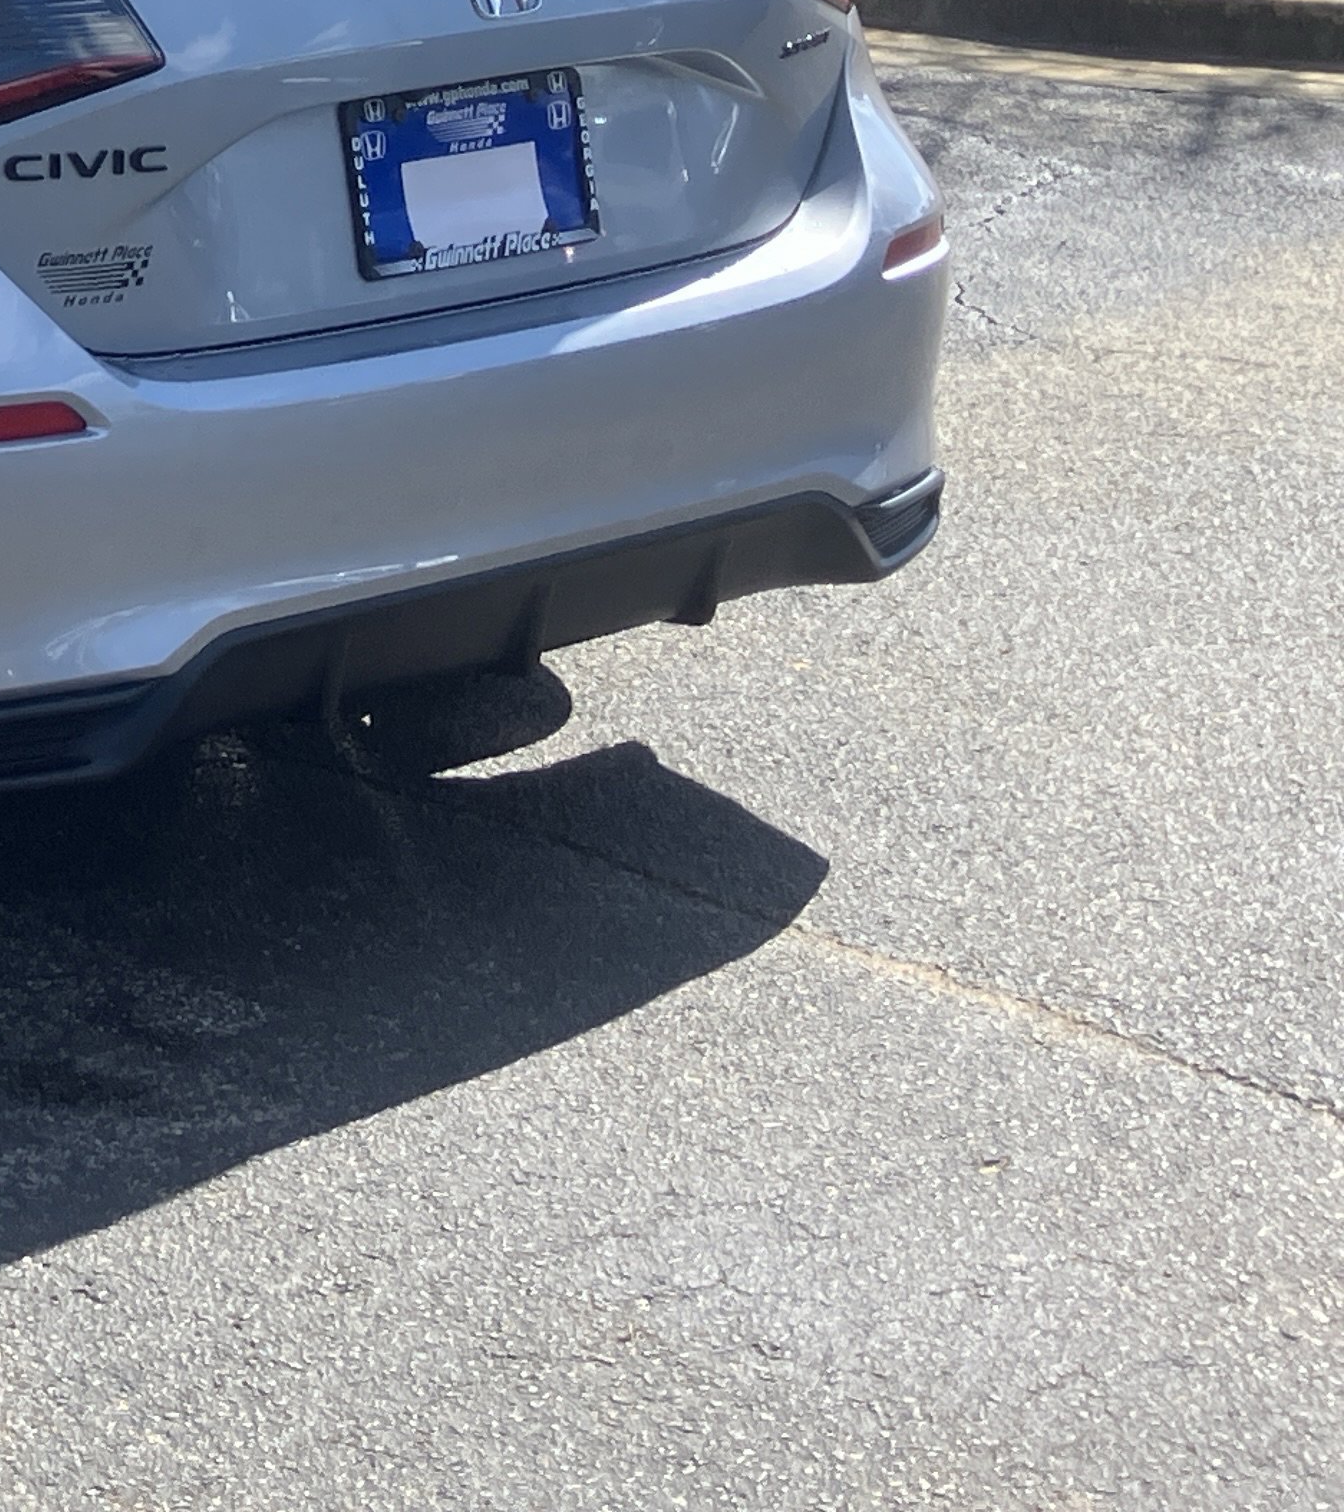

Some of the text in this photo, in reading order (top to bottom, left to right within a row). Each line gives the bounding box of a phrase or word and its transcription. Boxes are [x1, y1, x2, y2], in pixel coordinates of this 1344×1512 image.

[3, 145, 169, 182] CIVIC
[449, 137, 493, 153] Honda
[576, 96, 600, 210] GEORGIA
[351, 137, 376, 246] DULUTH
[37, 244, 154, 268] Gwinnett Place
[424, 229, 551, 271] Gwinnett Place
[63, 291, 124, 307] Honda
